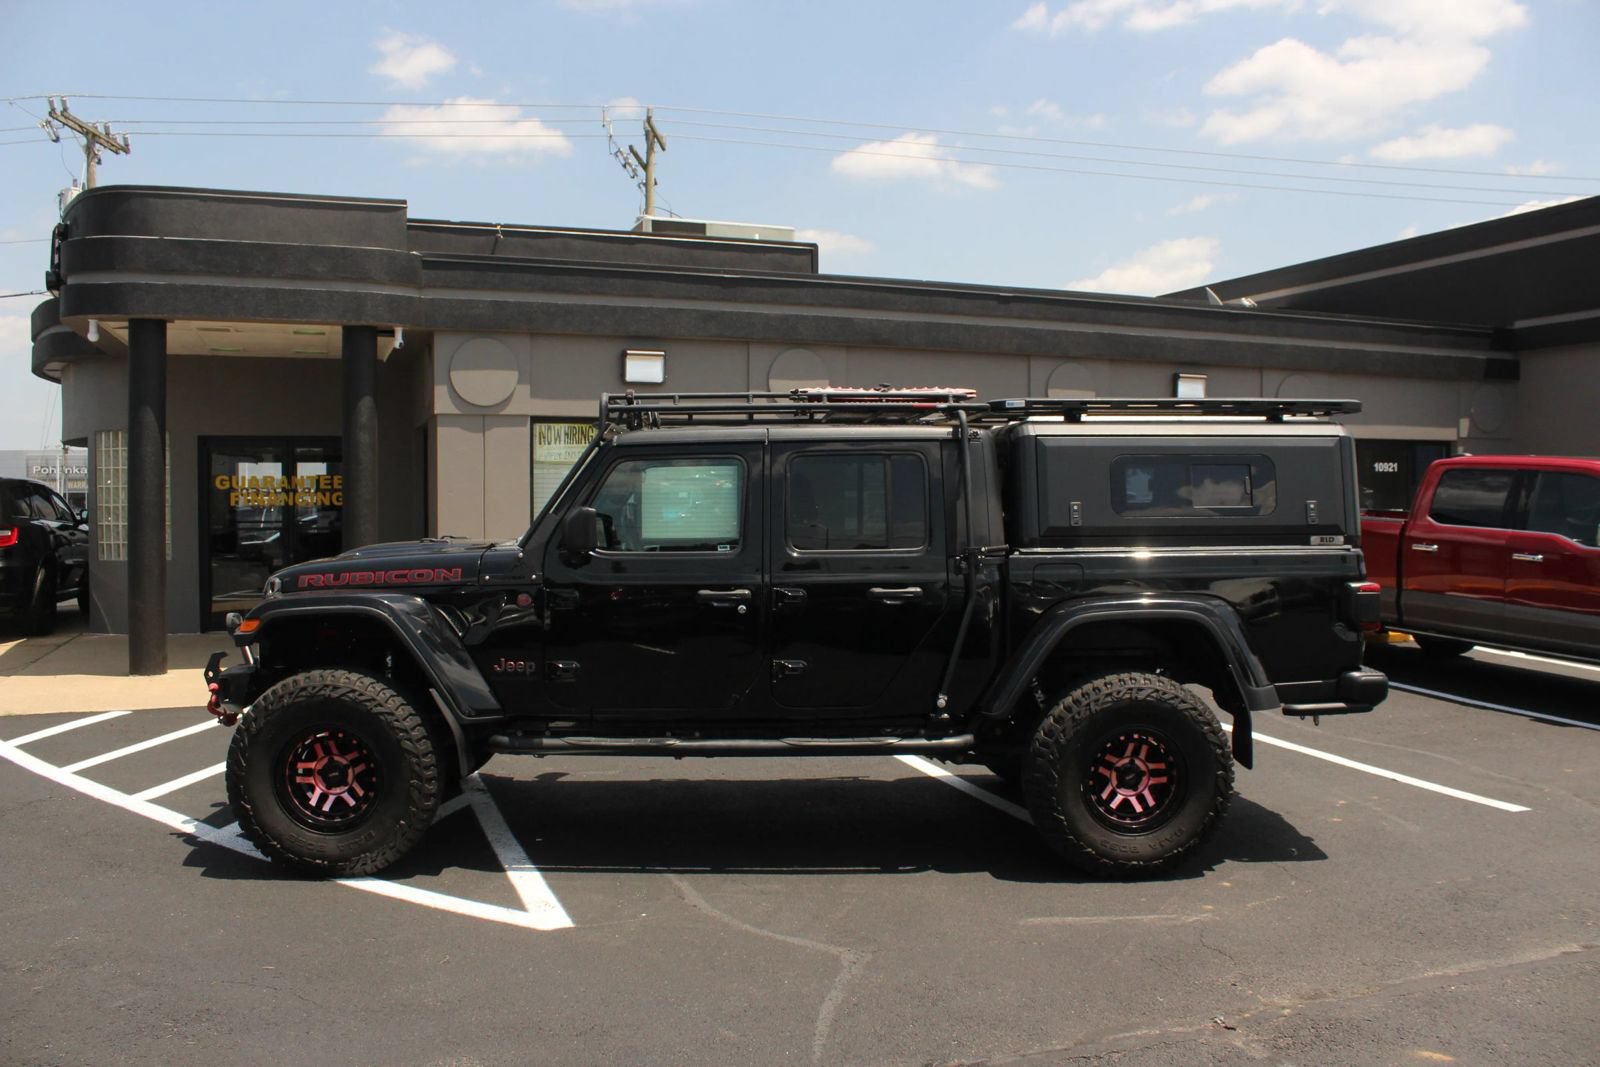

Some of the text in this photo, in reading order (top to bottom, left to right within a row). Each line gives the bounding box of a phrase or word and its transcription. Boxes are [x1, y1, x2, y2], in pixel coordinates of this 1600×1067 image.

[539, 425, 594, 445] NOW HIRING
[33, 465, 88, 474] Pohnka
[1373, 462, 1398, 472] 10921
[215, 474, 343, 489] GUARANTEE
[230, 492, 343, 506] FINANCING
[297, 568, 462, 587] RUBICON
[493, 658, 536, 675] Jeep
